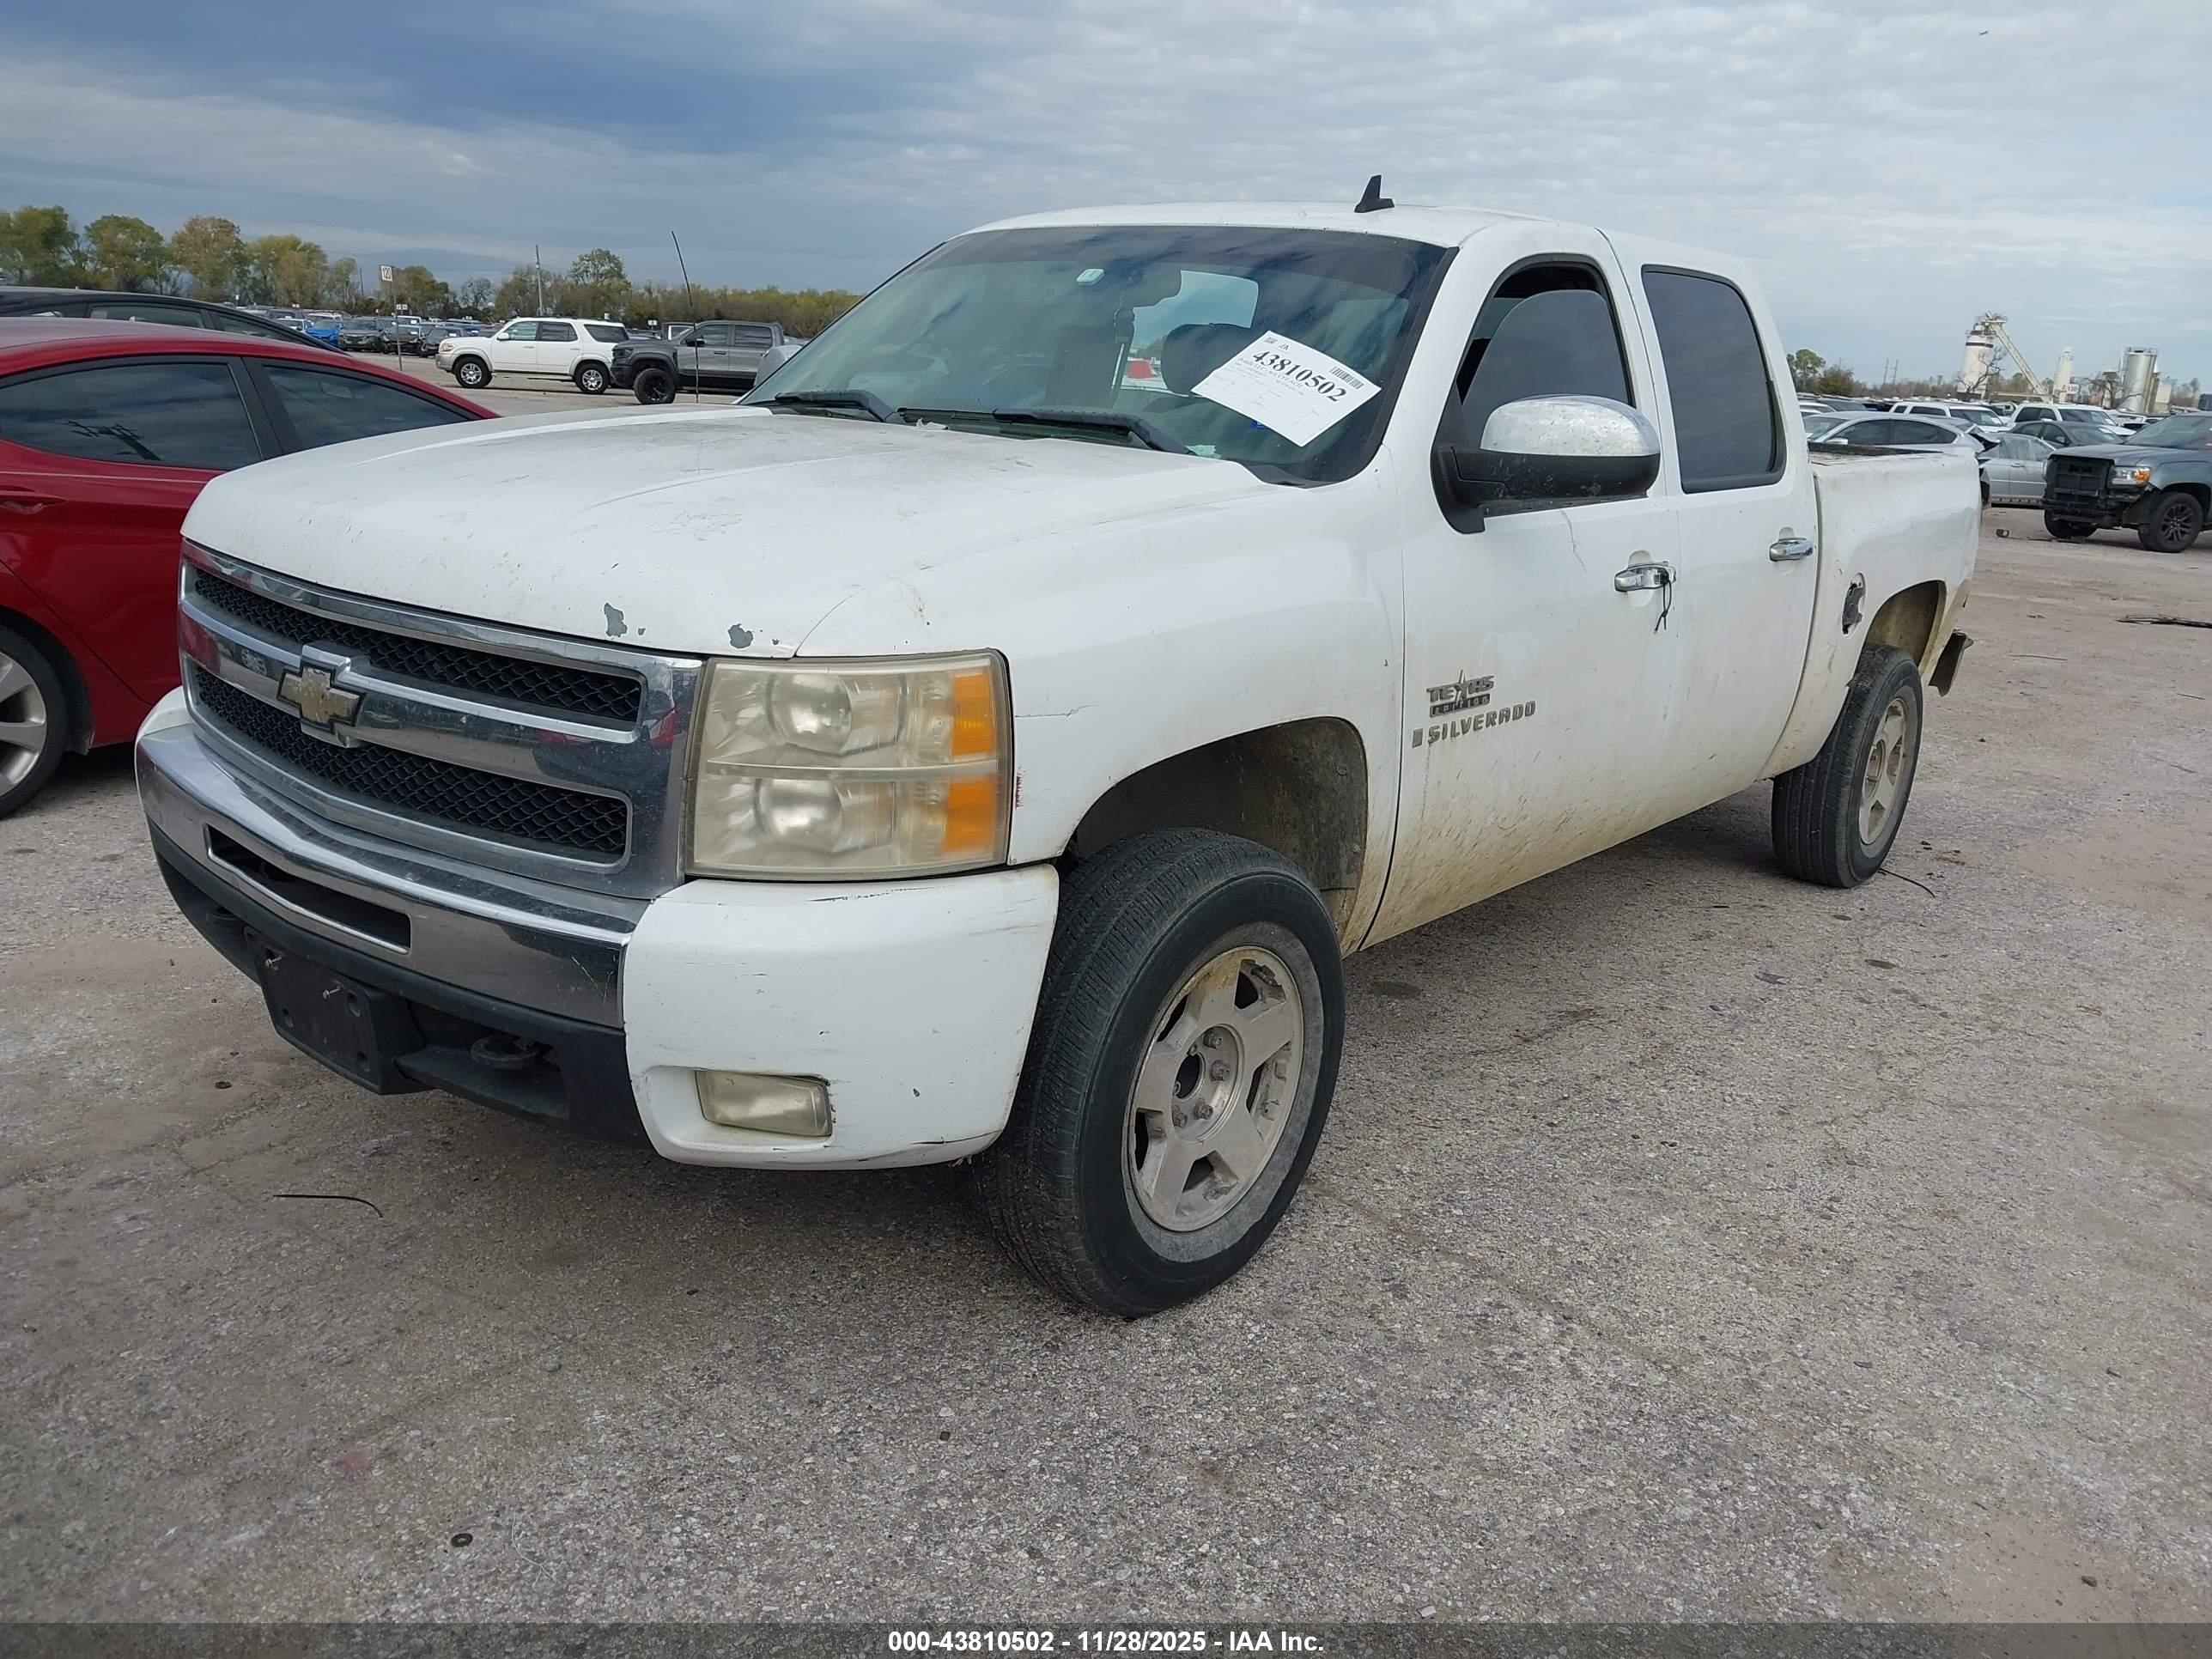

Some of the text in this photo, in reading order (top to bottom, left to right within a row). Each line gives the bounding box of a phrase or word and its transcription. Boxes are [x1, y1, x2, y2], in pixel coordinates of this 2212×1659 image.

[1253, 350, 1346, 402] 43810502
[1426, 671, 1494, 703] TEXAS
[1428, 701, 1536, 744] SILVERADO
